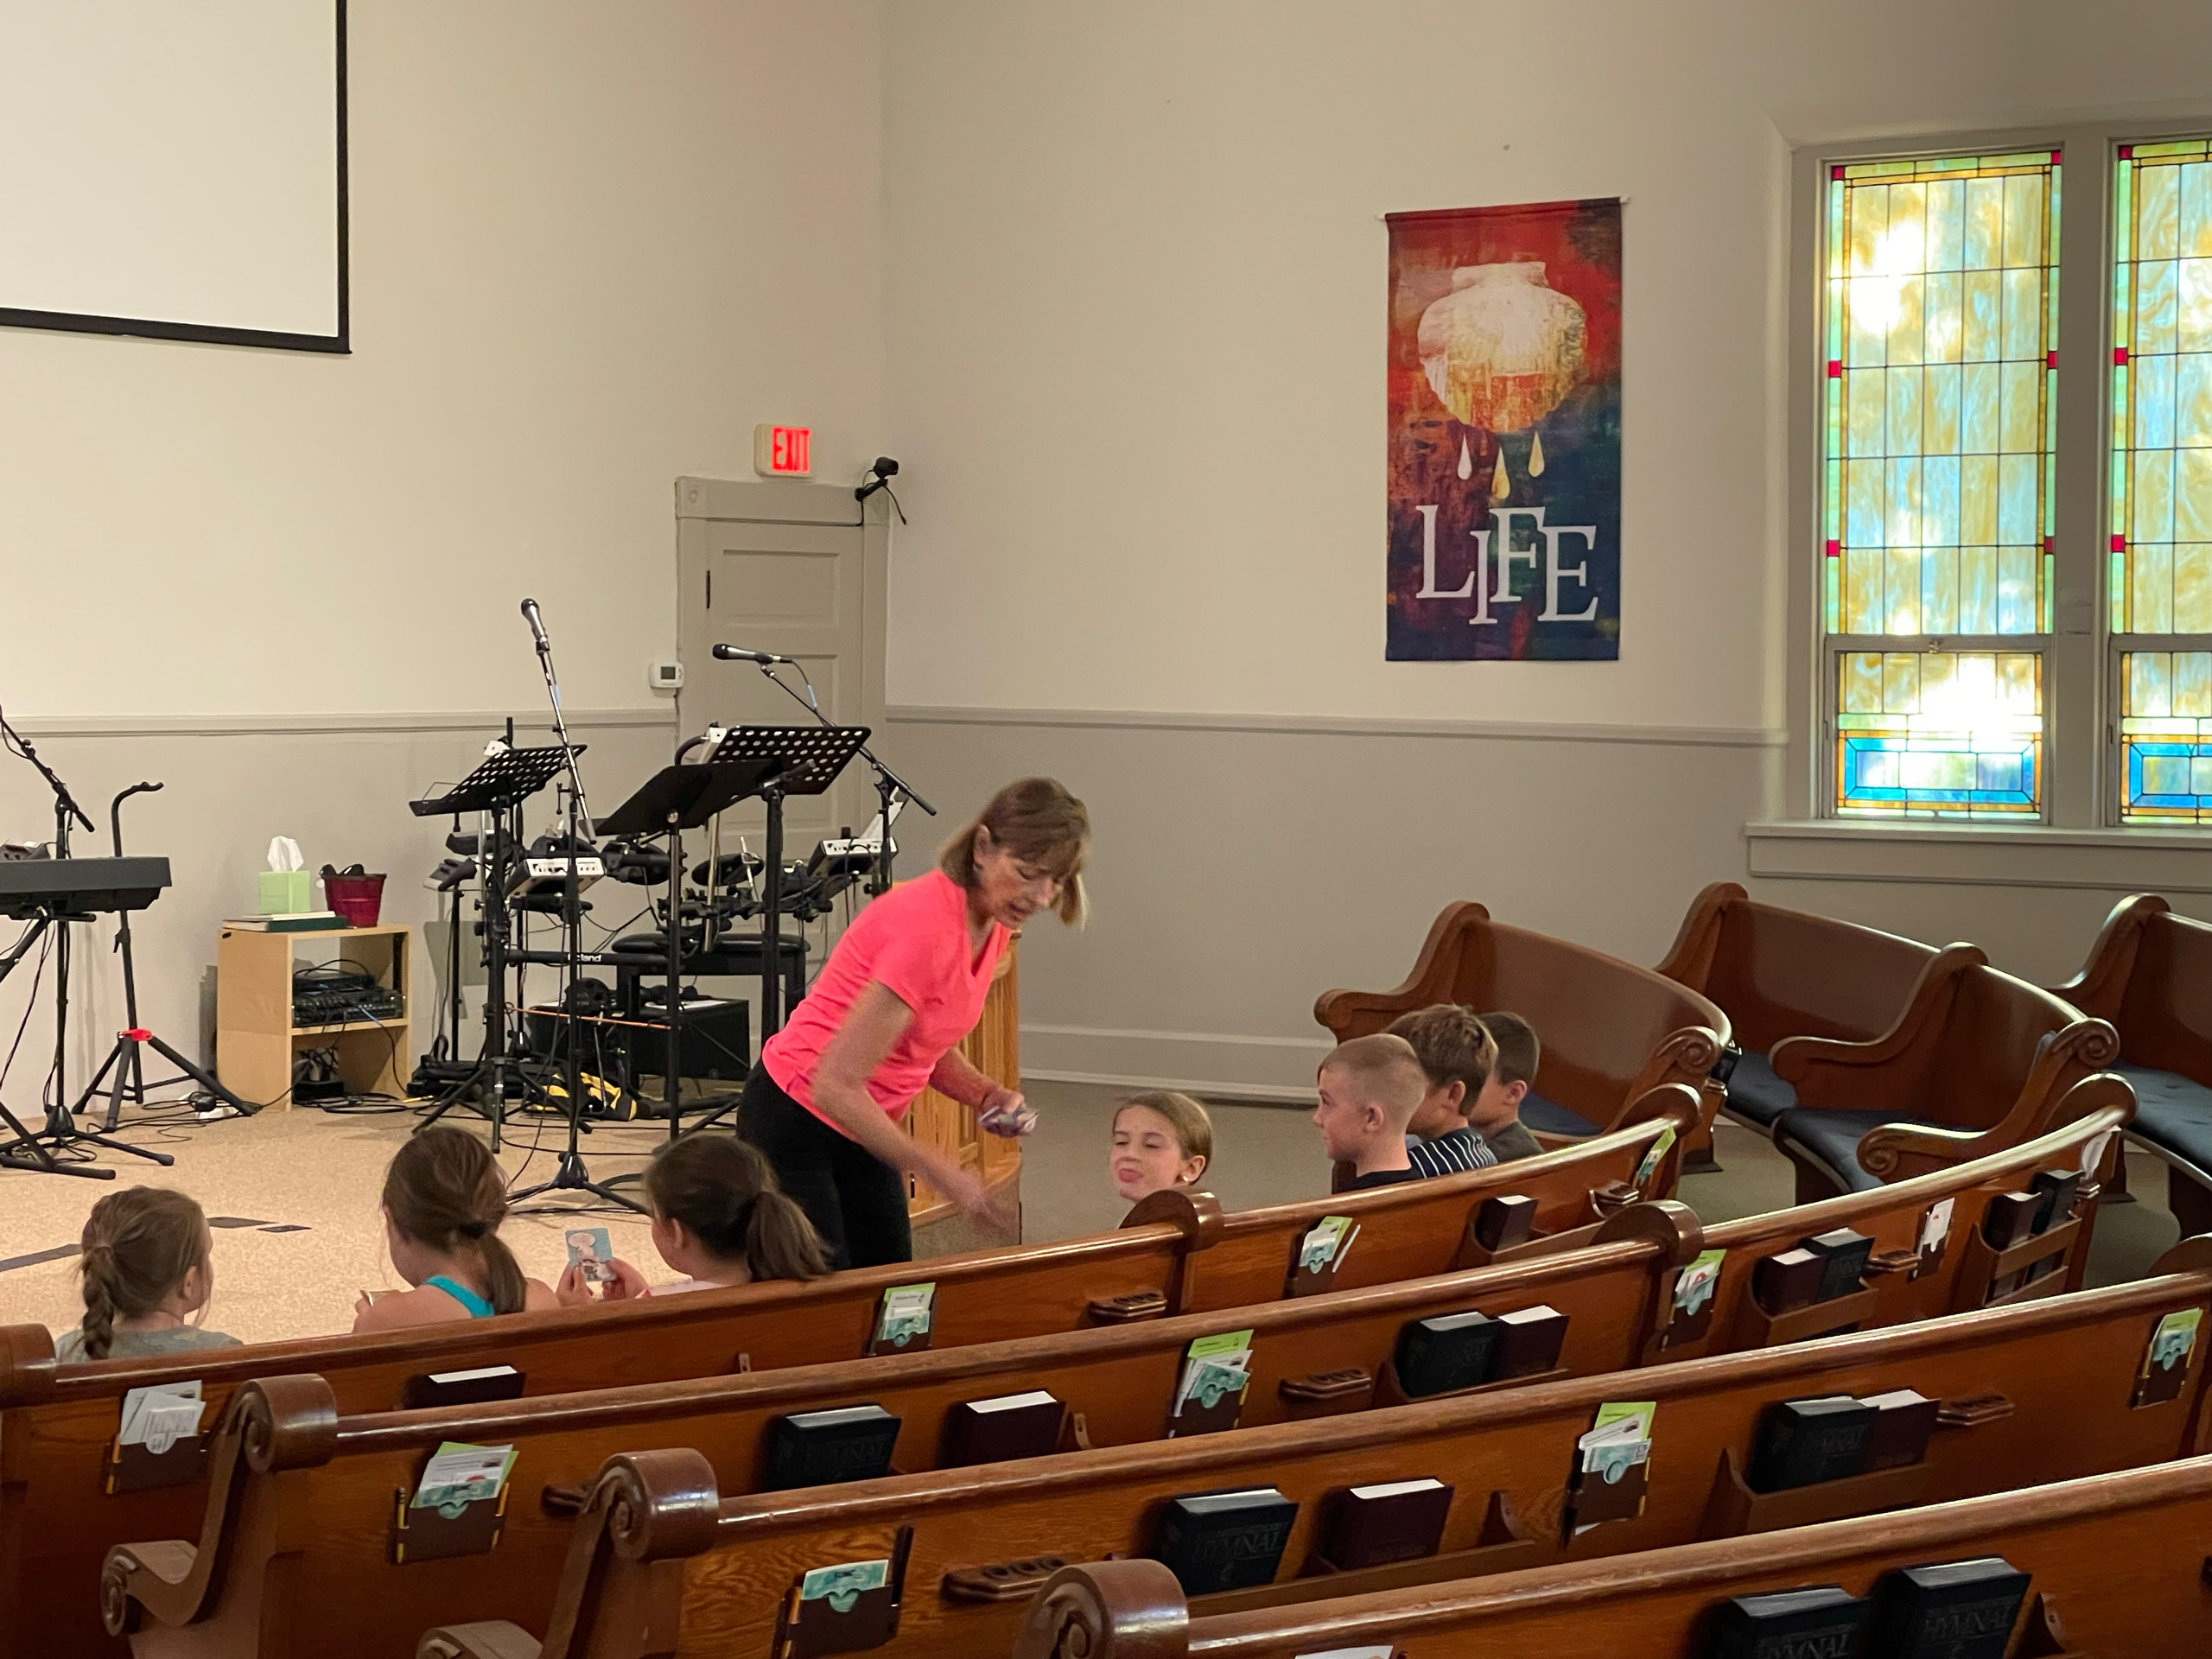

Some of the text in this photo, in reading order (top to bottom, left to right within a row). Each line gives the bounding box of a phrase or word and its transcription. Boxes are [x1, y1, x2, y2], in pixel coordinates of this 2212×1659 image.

[772, 426, 811, 474] EXIT
[1415, 504, 1599, 625] LIFE
[568, 953, 602, 962] land
